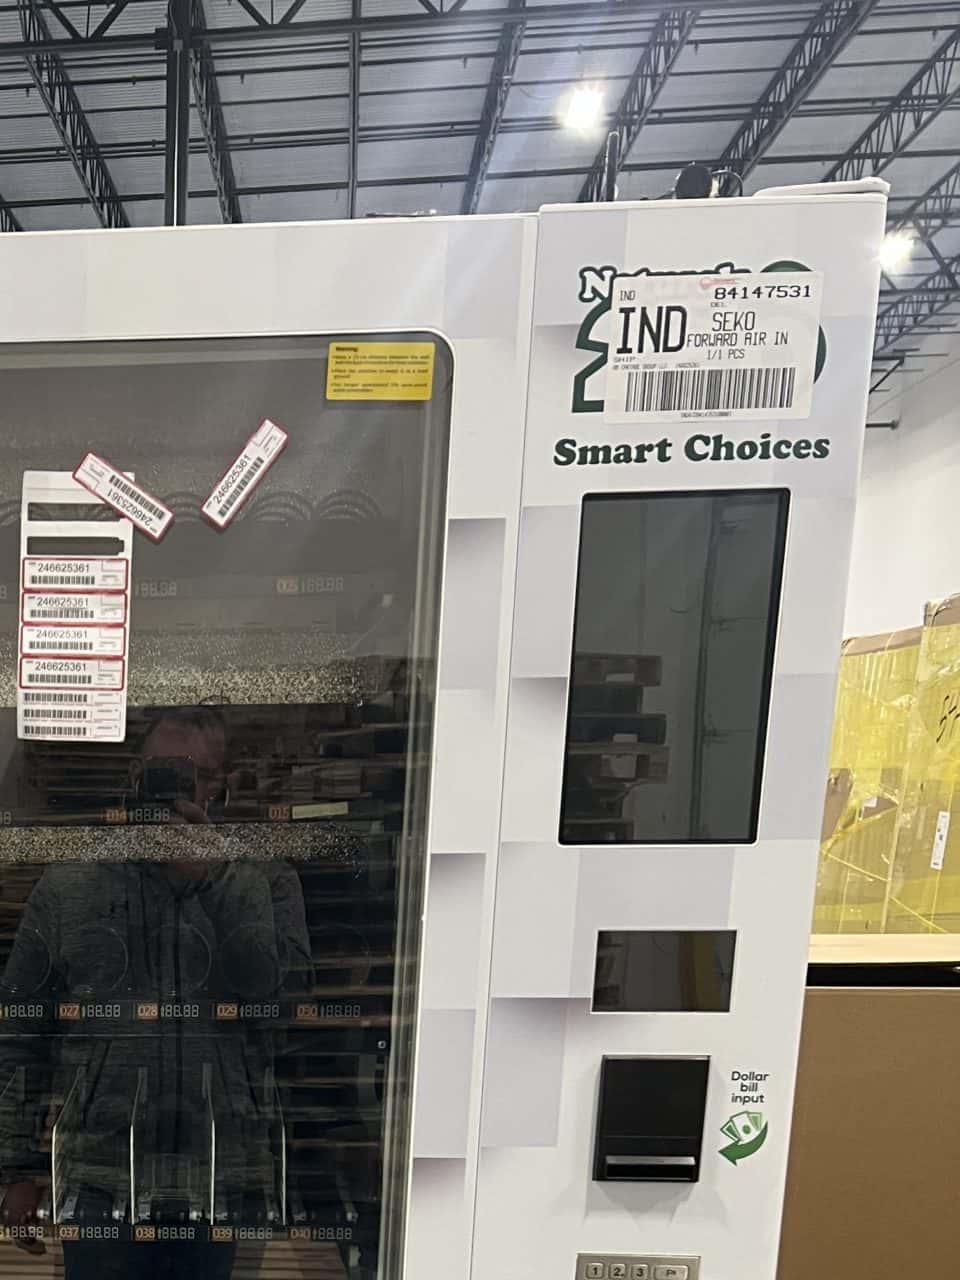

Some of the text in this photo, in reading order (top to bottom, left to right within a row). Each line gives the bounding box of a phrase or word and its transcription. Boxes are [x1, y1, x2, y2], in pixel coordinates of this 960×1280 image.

[619, 285, 811, 301] IND 84147531
[712, 311, 756, 332] SEKO
[616, 306, 687, 354] IND
[687, 331, 788, 348] FORWARD AIR IN
[707, 348, 746, 360] 1/1 PCS
[553, 433, 831, 466] Smart Choices
[213, 454, 251, 504] 246625361
[107, 489, 153, 527] 246625361
[37, 563, 90, 573] 246625361
[36, 597, 89, 607] 246625361
[35, 629, 88, 639] 246625361
[35, 661, 87, 671] 246625361
[60, 1006, 80, 1017] 027
[138, 1006, 158, 1017] 028
[218, 1006, 237, 1017] 029
[297, 1006, 317, 1018] 030
[730, 1071, 769, 1082] Dollar
[739, 1081, 758, 1092] bill
[731, 1093, 765, 1106] input
[60, 1227, 78, 1238] 037
[136, 1227, 155, 1238] 038
[213, 1228, 232, 1239] 039
[291, 1228, 310, 1239] 040
[593, 1267, 598, 1276] 1
[636, 1268, 644, 1277] 3
